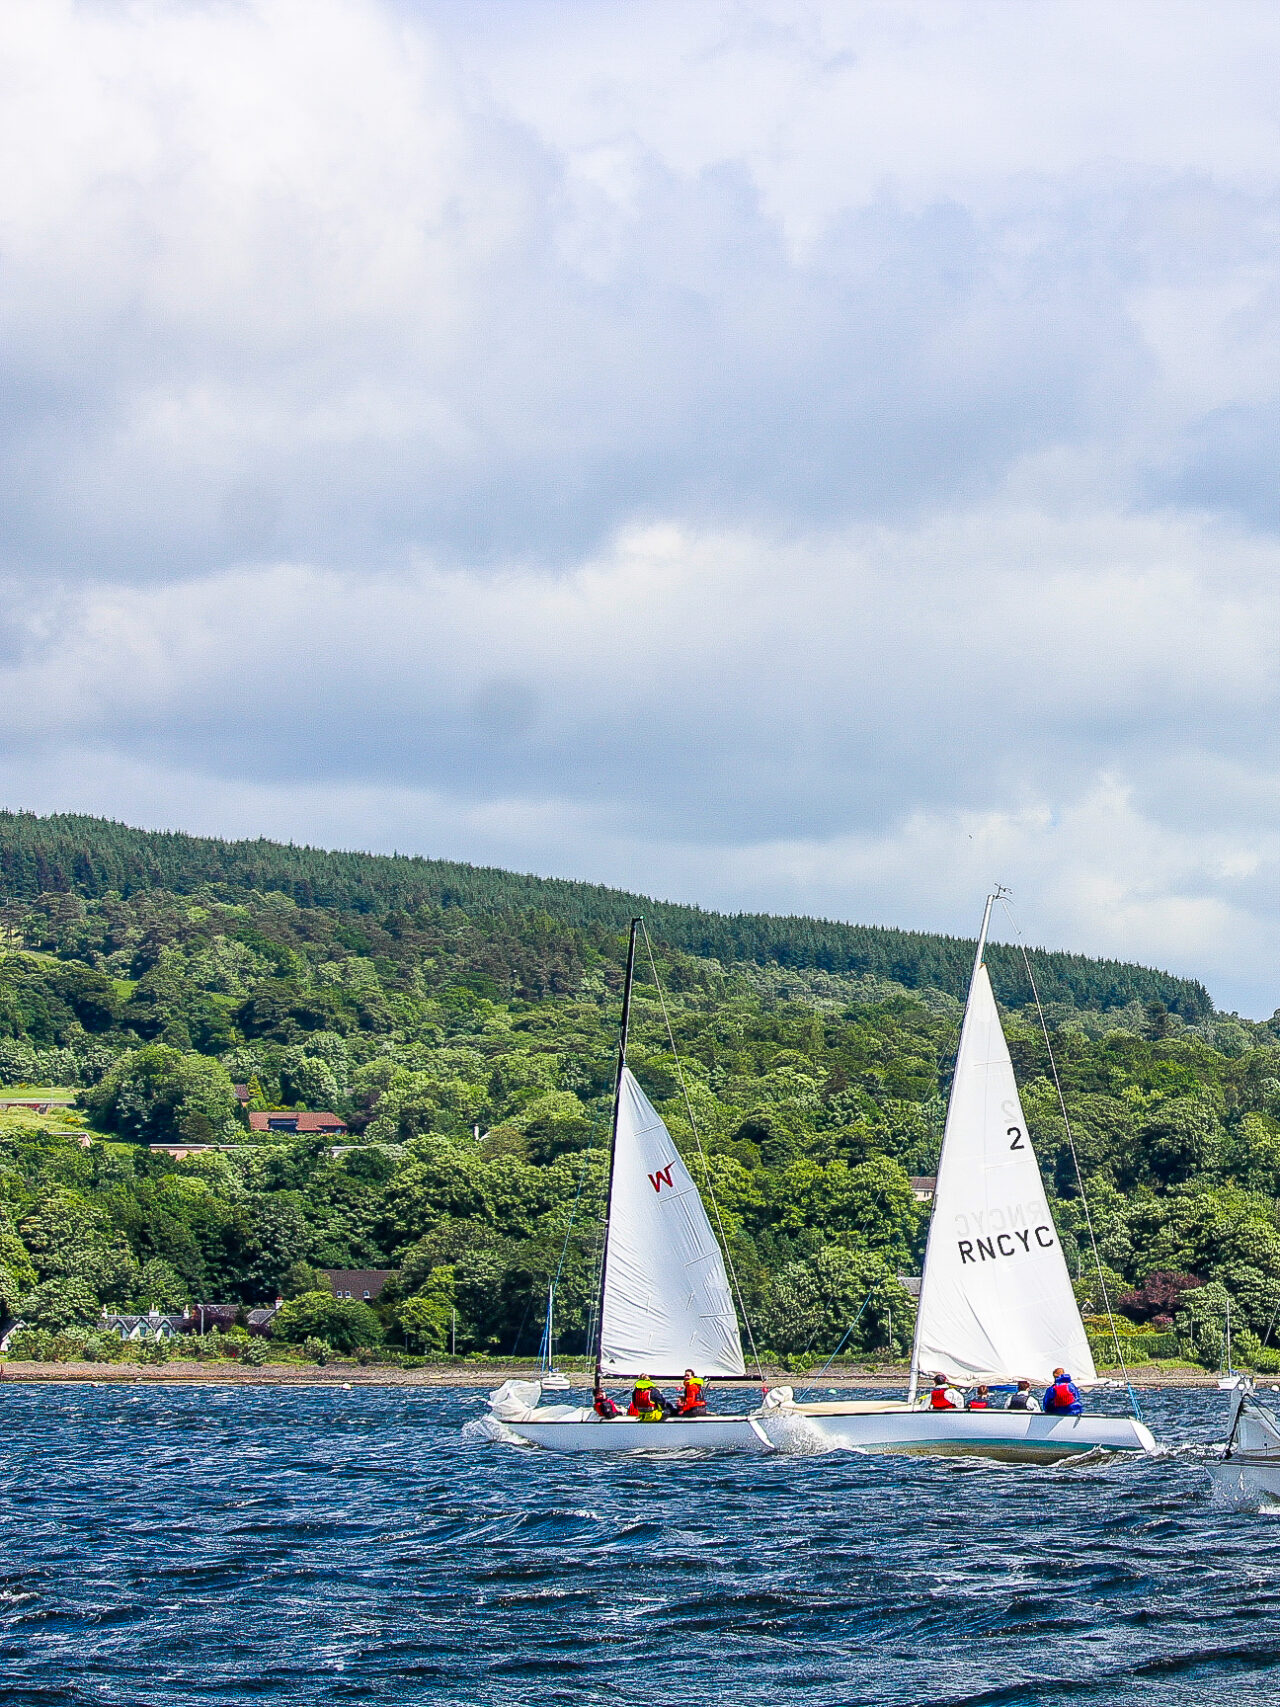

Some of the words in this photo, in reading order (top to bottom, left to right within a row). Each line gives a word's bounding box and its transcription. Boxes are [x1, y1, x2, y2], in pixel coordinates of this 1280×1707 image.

[1007, 1127, 1024, 1150] 2
[648, 1160, 675, 1193] W
[958, 1226, 1053, 1264] RNCYC
